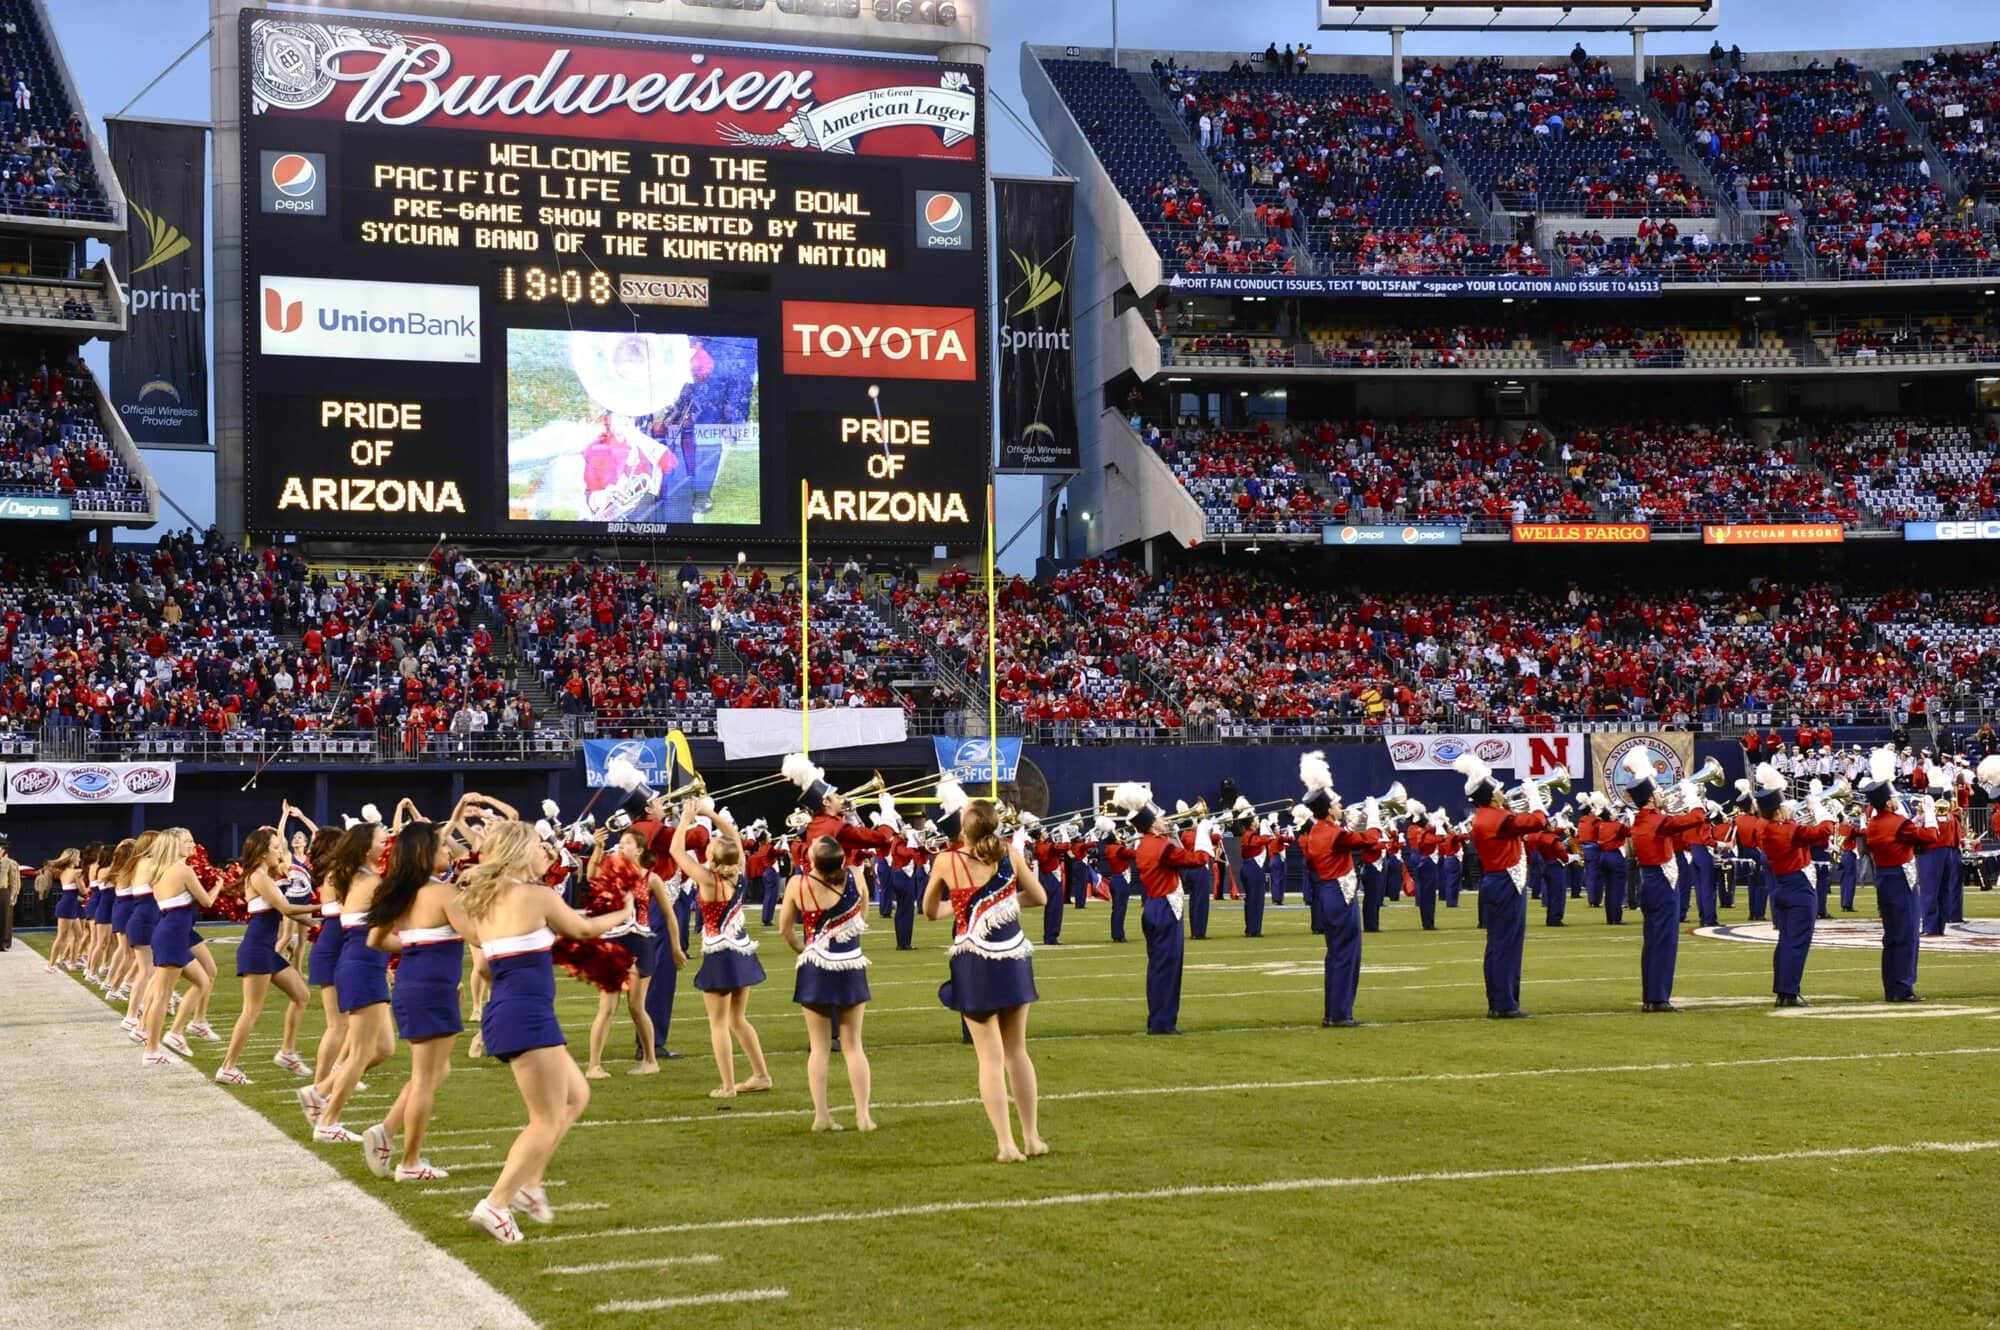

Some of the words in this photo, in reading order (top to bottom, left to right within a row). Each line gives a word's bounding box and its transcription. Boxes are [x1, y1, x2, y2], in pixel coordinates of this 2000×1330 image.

[320, 43, 815, 126] Budweiser
[868, 90, 885, 100] The
[886, 88, 913, 99] Great
[821, 102, 910, 139] American
[914, 98, 971, 123] Lager
[489, 143, 632, 175] WELCOME
[651, 153, 691, 178] TO
[709, 157, 768, 182] THE
[374, 165, 520, 197] PACIFIC
[540, 176, 621, 202] LIFE
[640, 181, 777, 211] HOLIDAY
[794, 190, 871, 217] BOWL
[274, 199, 314, 212] pepsi
[393, 198, 523, 224] PRE-GAME
[538, 207, 601, 229] SHOW
[616, 212, 753, 236] PRESENTED
[768, 219, 798, 239] BY
[812, 222, 857, 241] THE
[360, 221, 460, 247] SYCUAN
[475, 229, 539, 251] BAND
[554, 232, 584, 254] OF
[601, 234, 648, 257] THE
[662, 238, 784, 264] KUMEYAAY
[797, 244, 887, 269] NATION
[927, 234, 962, 248] pepsi
[620, 280, 709, 300] SYCUAN
[1210, 278, 1231, 289] FAN
[1233, 279, 1283, 290] CONDUCT
[1286, 280, 1326, 292] ISSUES,
[1328, 280, 1354, 291] TEXT
[1466, 281, 1496, 291] YOUR
[1497, 281, 1552, 292] LOCATION
[1554, 282, 1577, 292] AND
[1578, 282, 1609, 292] ISSUE
[1611, 281, 1626, 292] TO
[1627, 280, 1660, 292] 41513
[318, 308, 476, 337] UnionBank
[792, 323, 968, 362] TOYOTA
[1000, 325, 1071, 355] Sprint
[120, 402, 156, 417] Official
[157, 405, 199, 418] Wireless
[321, 400, 422, 431] PRIDE
[141, 415, 183, 428] Provider
[841, 418, 931, 445] PRIDE
[350, 439, 394, 466] OF
[1006, 444, 1035, 456] Official
[1037, 445, 1072, 456] Wireless
[1022, 454, 1057, 464] Provider
[867, 453, 905, 480] OF
[277, 476, 466, 514] ARIZONA
[8, 501, 60, 518] Degree
[807, 489, 970, 524] ARIZONA
[607, 522, 629, 533] BOLT
[1358, 531, 1385, 541] pepsi
[1419, 531, 1446, 541] pepsi
[1515, 526, 1581, 541] WELLS
[1584, 526, 1647, 541] FARGO
[1736, 529, 1786, 539] SYCUAN
[1791, 528, 1840, 539] RESORT
[1528, 737, 1570, 776] N
[1611, 738, 1647, 761] SYCUAN
[1648, 739, 1675, 760] BAND
[17, 774, 50, 792] Pepper
[130, 774, 162, 792] Pepper
[646, 768, 668, 785] LIF
